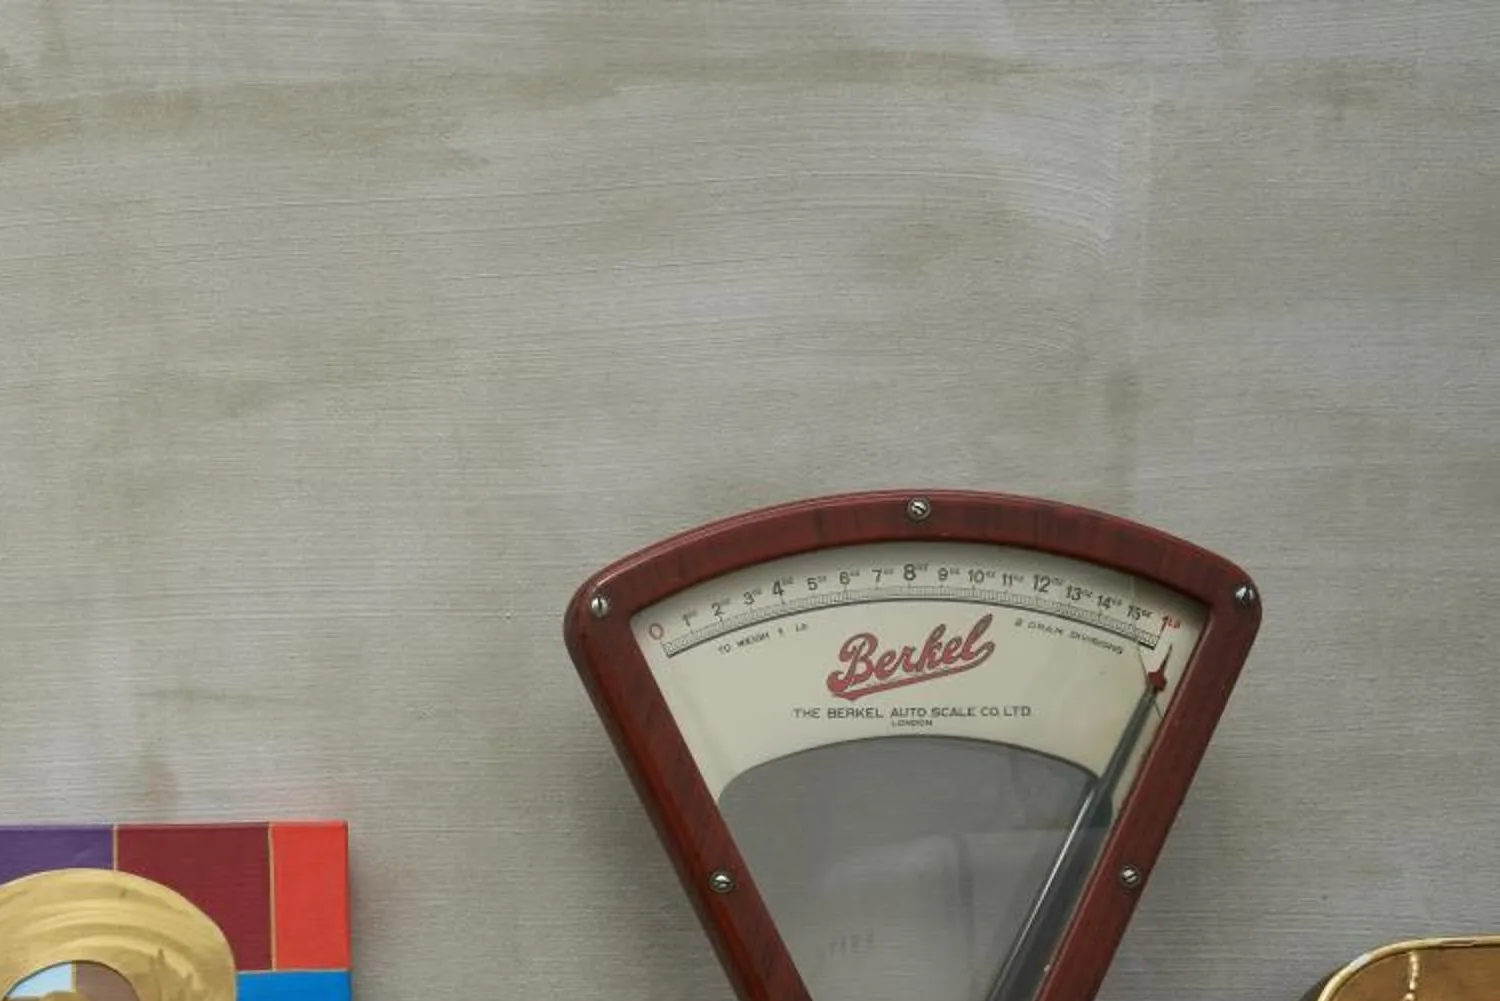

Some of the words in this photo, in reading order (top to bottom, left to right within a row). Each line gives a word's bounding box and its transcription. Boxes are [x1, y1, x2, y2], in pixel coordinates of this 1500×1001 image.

[826, 613, 996, 699] Berkel
[793, 707, 820, 719] THE
[827, 707, 884, 719] BERKEL
[890, 707, 927, 719] AUTO
[931, 706, 975, 718] SCALE
[1003, 705, 1032, 717] LTD
[891, 719, 933, 728] LONDON
